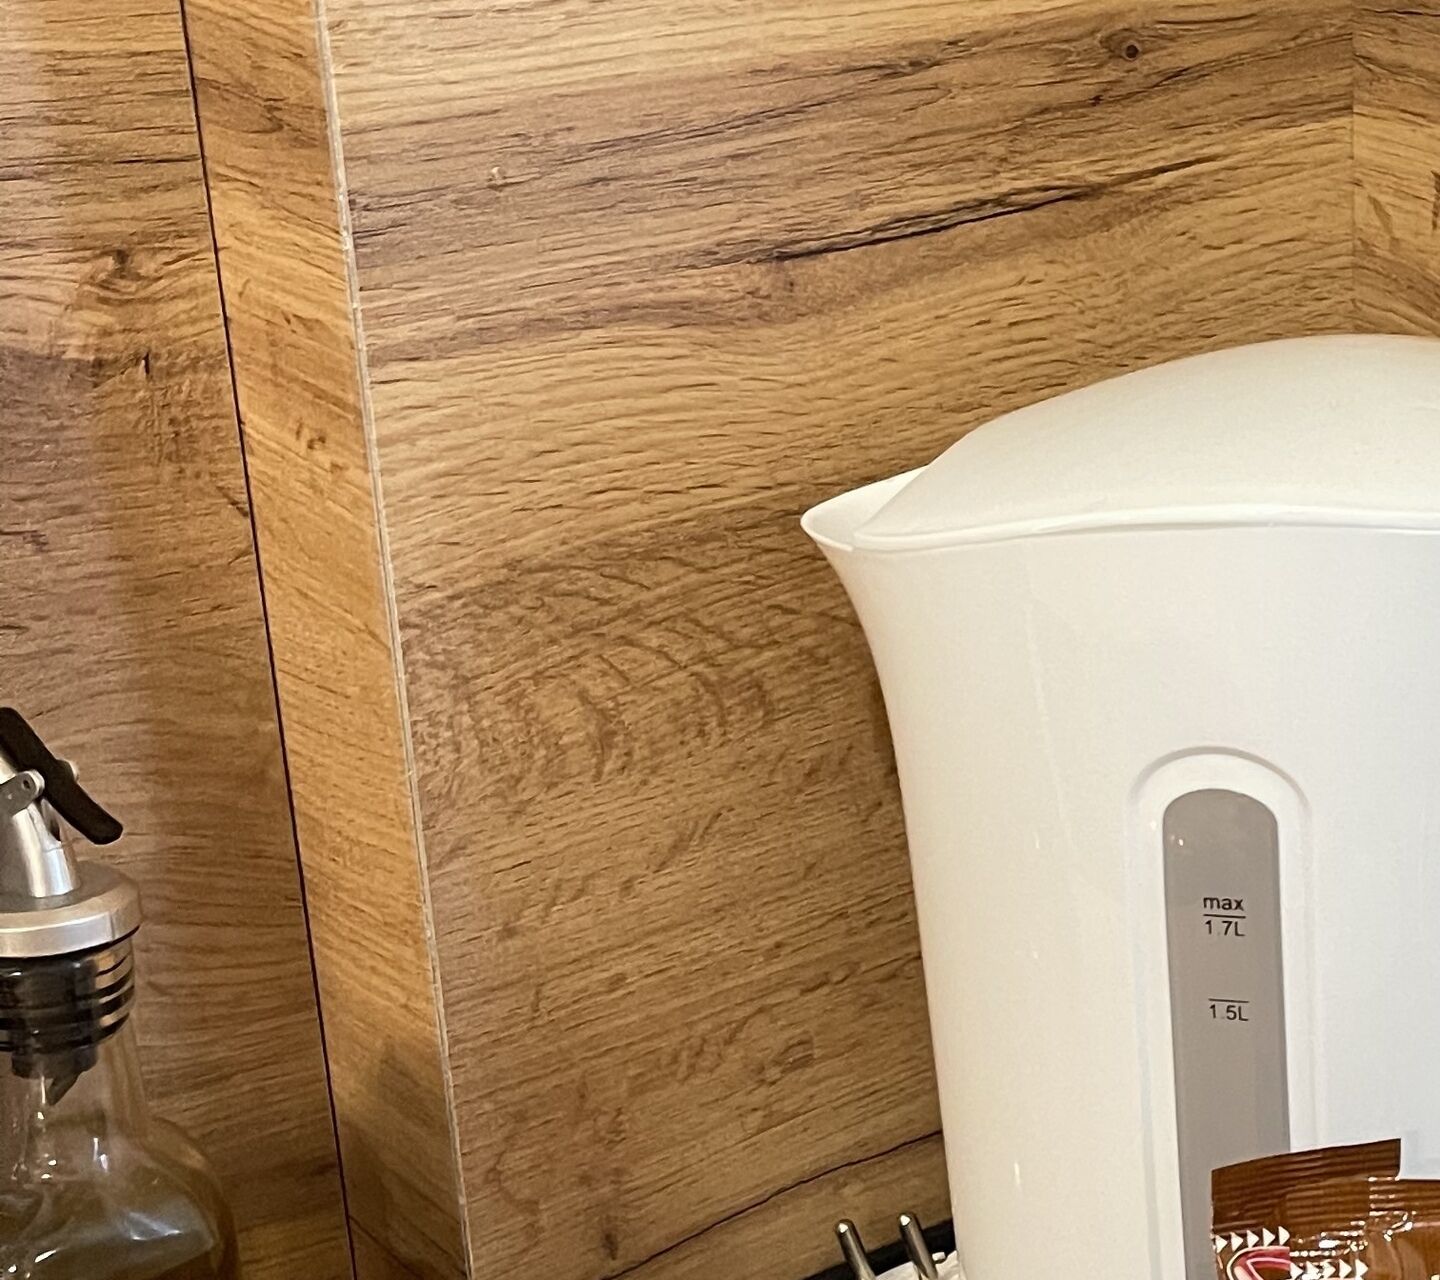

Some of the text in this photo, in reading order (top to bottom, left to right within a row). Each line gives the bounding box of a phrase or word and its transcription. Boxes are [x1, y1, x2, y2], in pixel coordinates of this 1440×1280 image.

[1202, 896, 1245, 911] max
[1204, 919, 1246, 937] 1.7L
[1209, 1004, 1249, 1022] 1.5L
